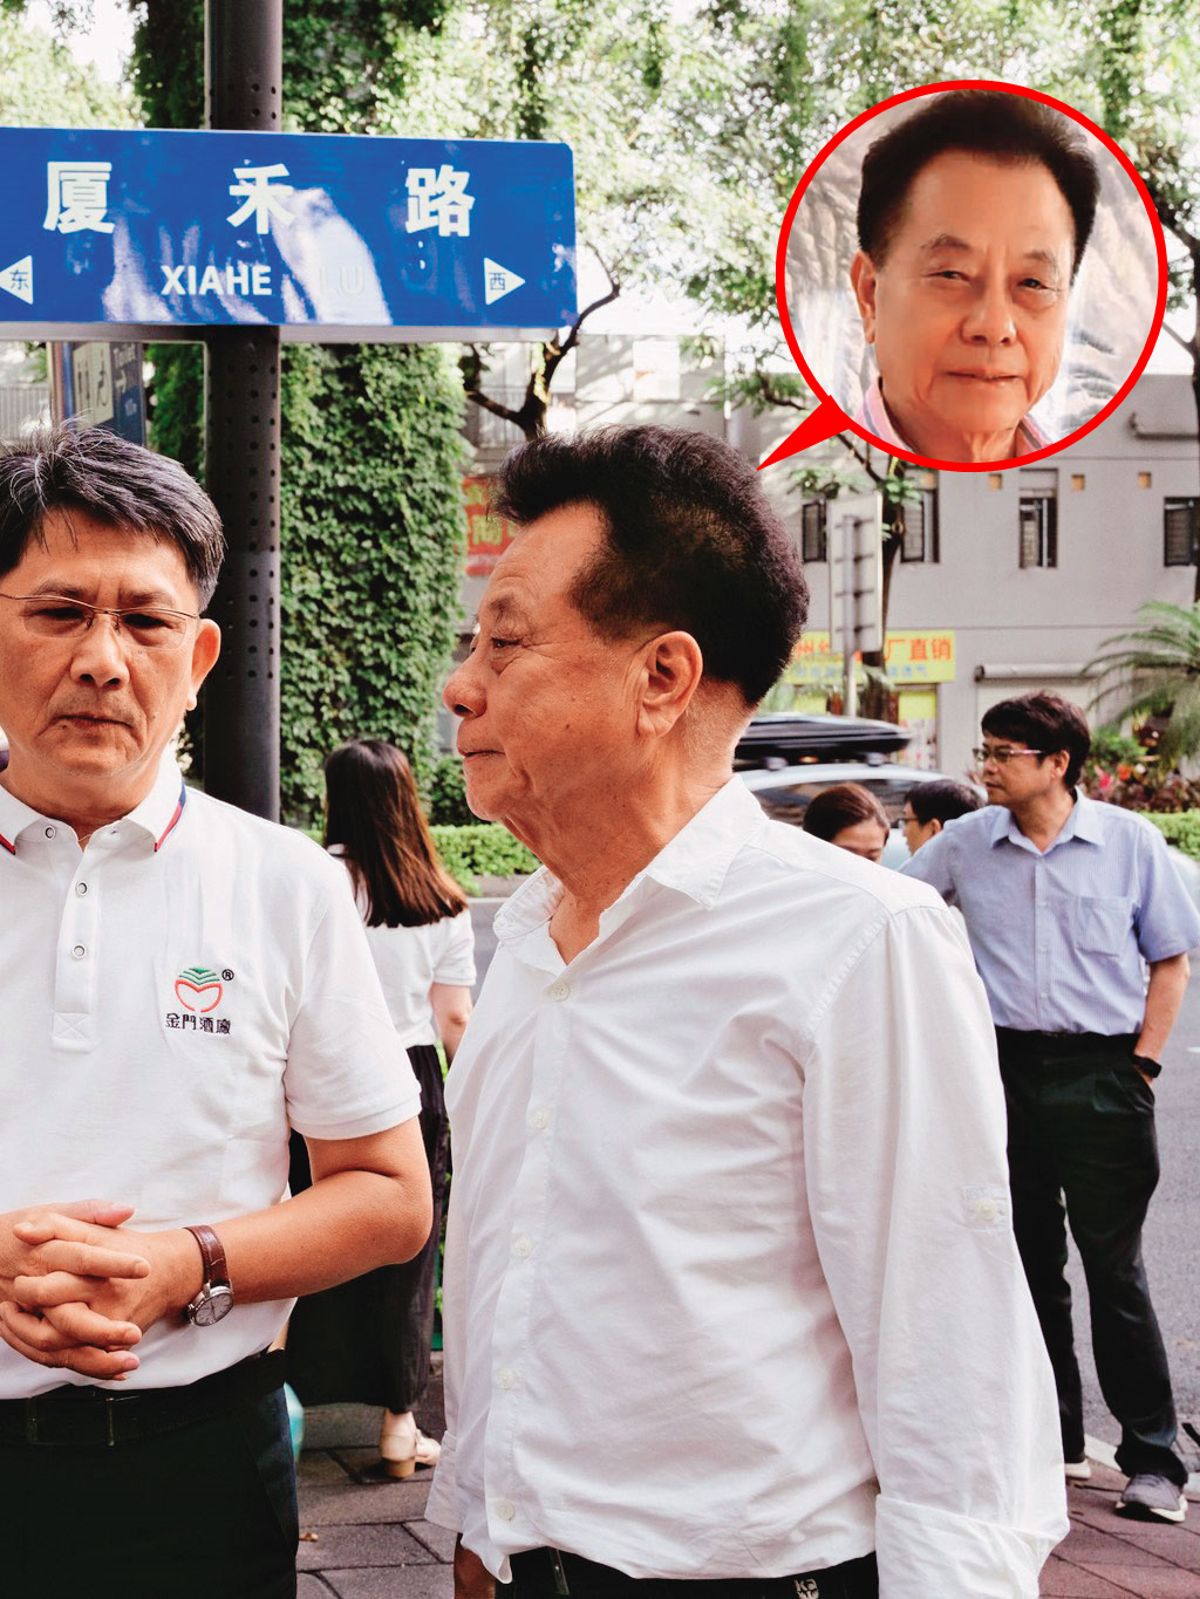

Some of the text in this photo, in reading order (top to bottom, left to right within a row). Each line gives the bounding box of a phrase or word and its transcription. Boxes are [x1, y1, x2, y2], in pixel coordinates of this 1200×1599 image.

[43, 161, 475, 238] 厦禾路
[9, 269, 30, 290] 东
[160, 265, 273, 296] XIAHE
[488, 272, 507, 291] 西
